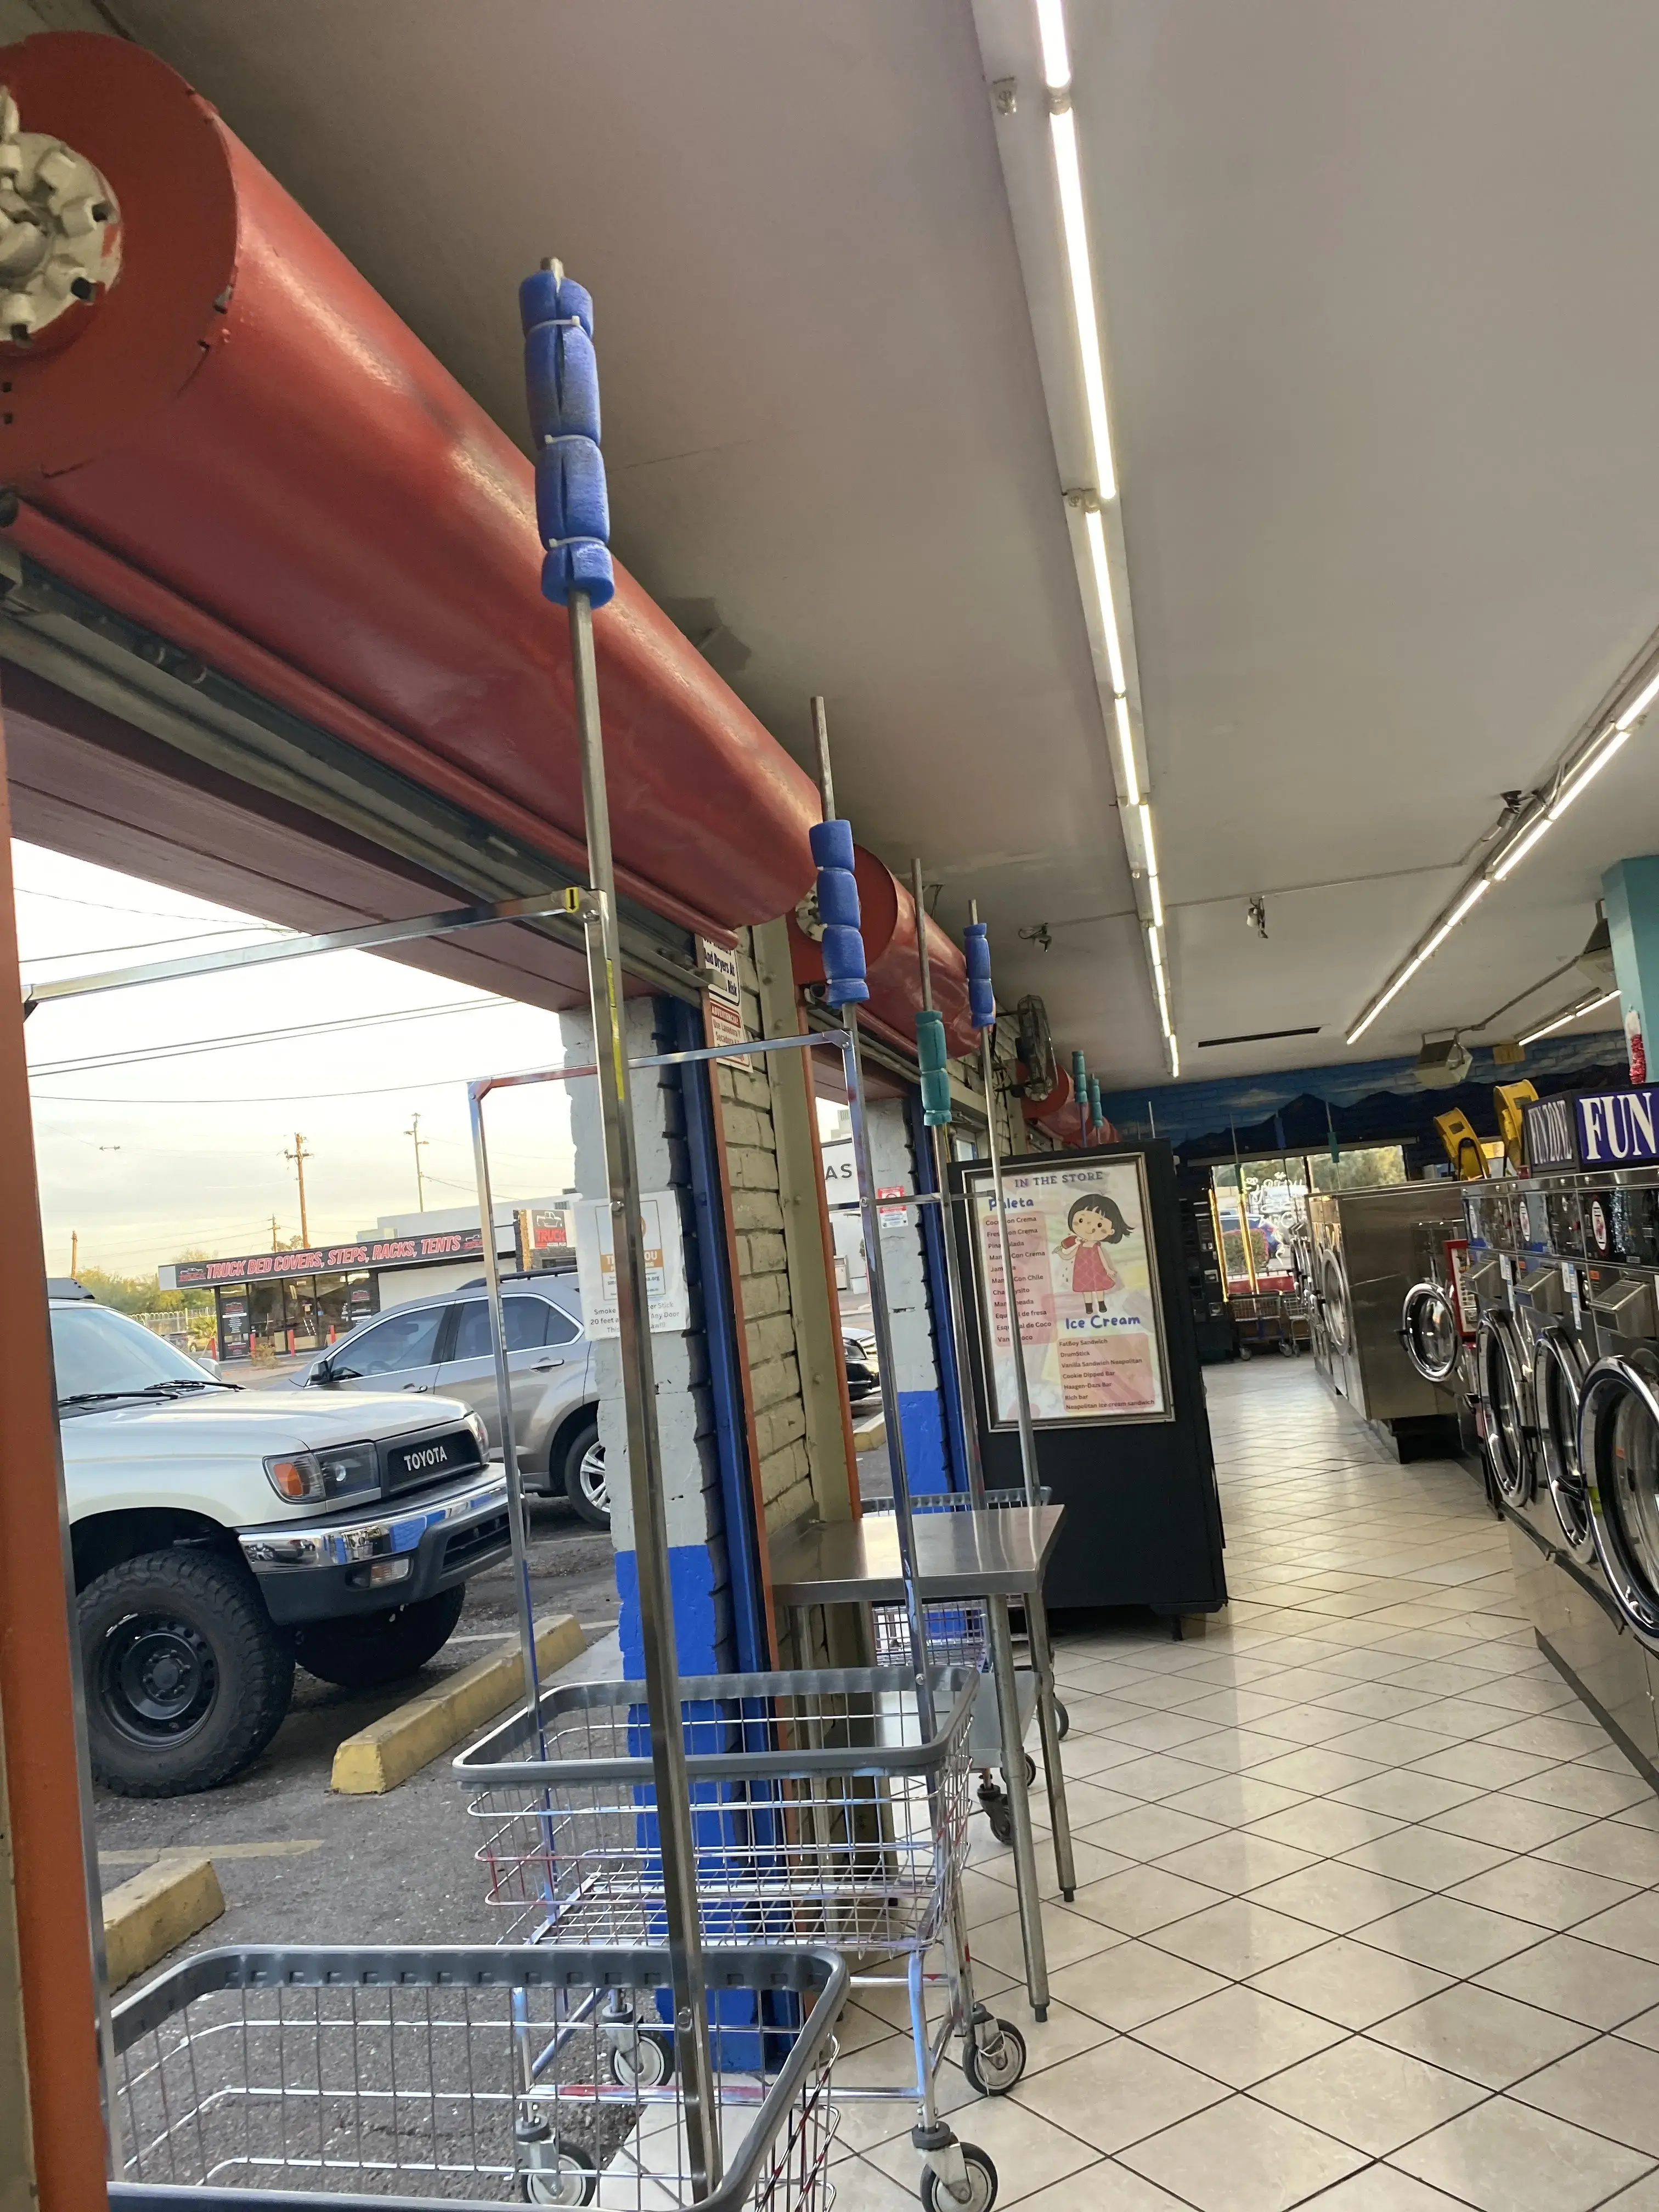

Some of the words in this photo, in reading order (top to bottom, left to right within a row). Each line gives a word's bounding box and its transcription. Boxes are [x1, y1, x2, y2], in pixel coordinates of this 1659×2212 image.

[714, 953, 729, 973] Dryers
[730, 962, 735, 977] At
[1579, 1092, 1656, 1160] FUN
[1015, 1178, 1029, 1188] IN
[1033, 1176, 1058, 1186] THE
[1062, 1171, 1103, 1183] STORE
[534, 1229, 566, 1242] TRUCK
[206, 1260, 246, 1279] TRUCK
[247, 1257, 272, 1275] BED
[274, 1251, 325, 1272] COVERS,
[327, 1245, 369, 1265] STEPS,
[372, 1241, 417, 1260] RACKS,
[421, 1235, 461, 1254] TENTS
[1065, 1318, 1085, 1330] Ice
[1091, 1315, 1141, 1329] Cream
[404, 1446, 448, 1471] TOYOTA
